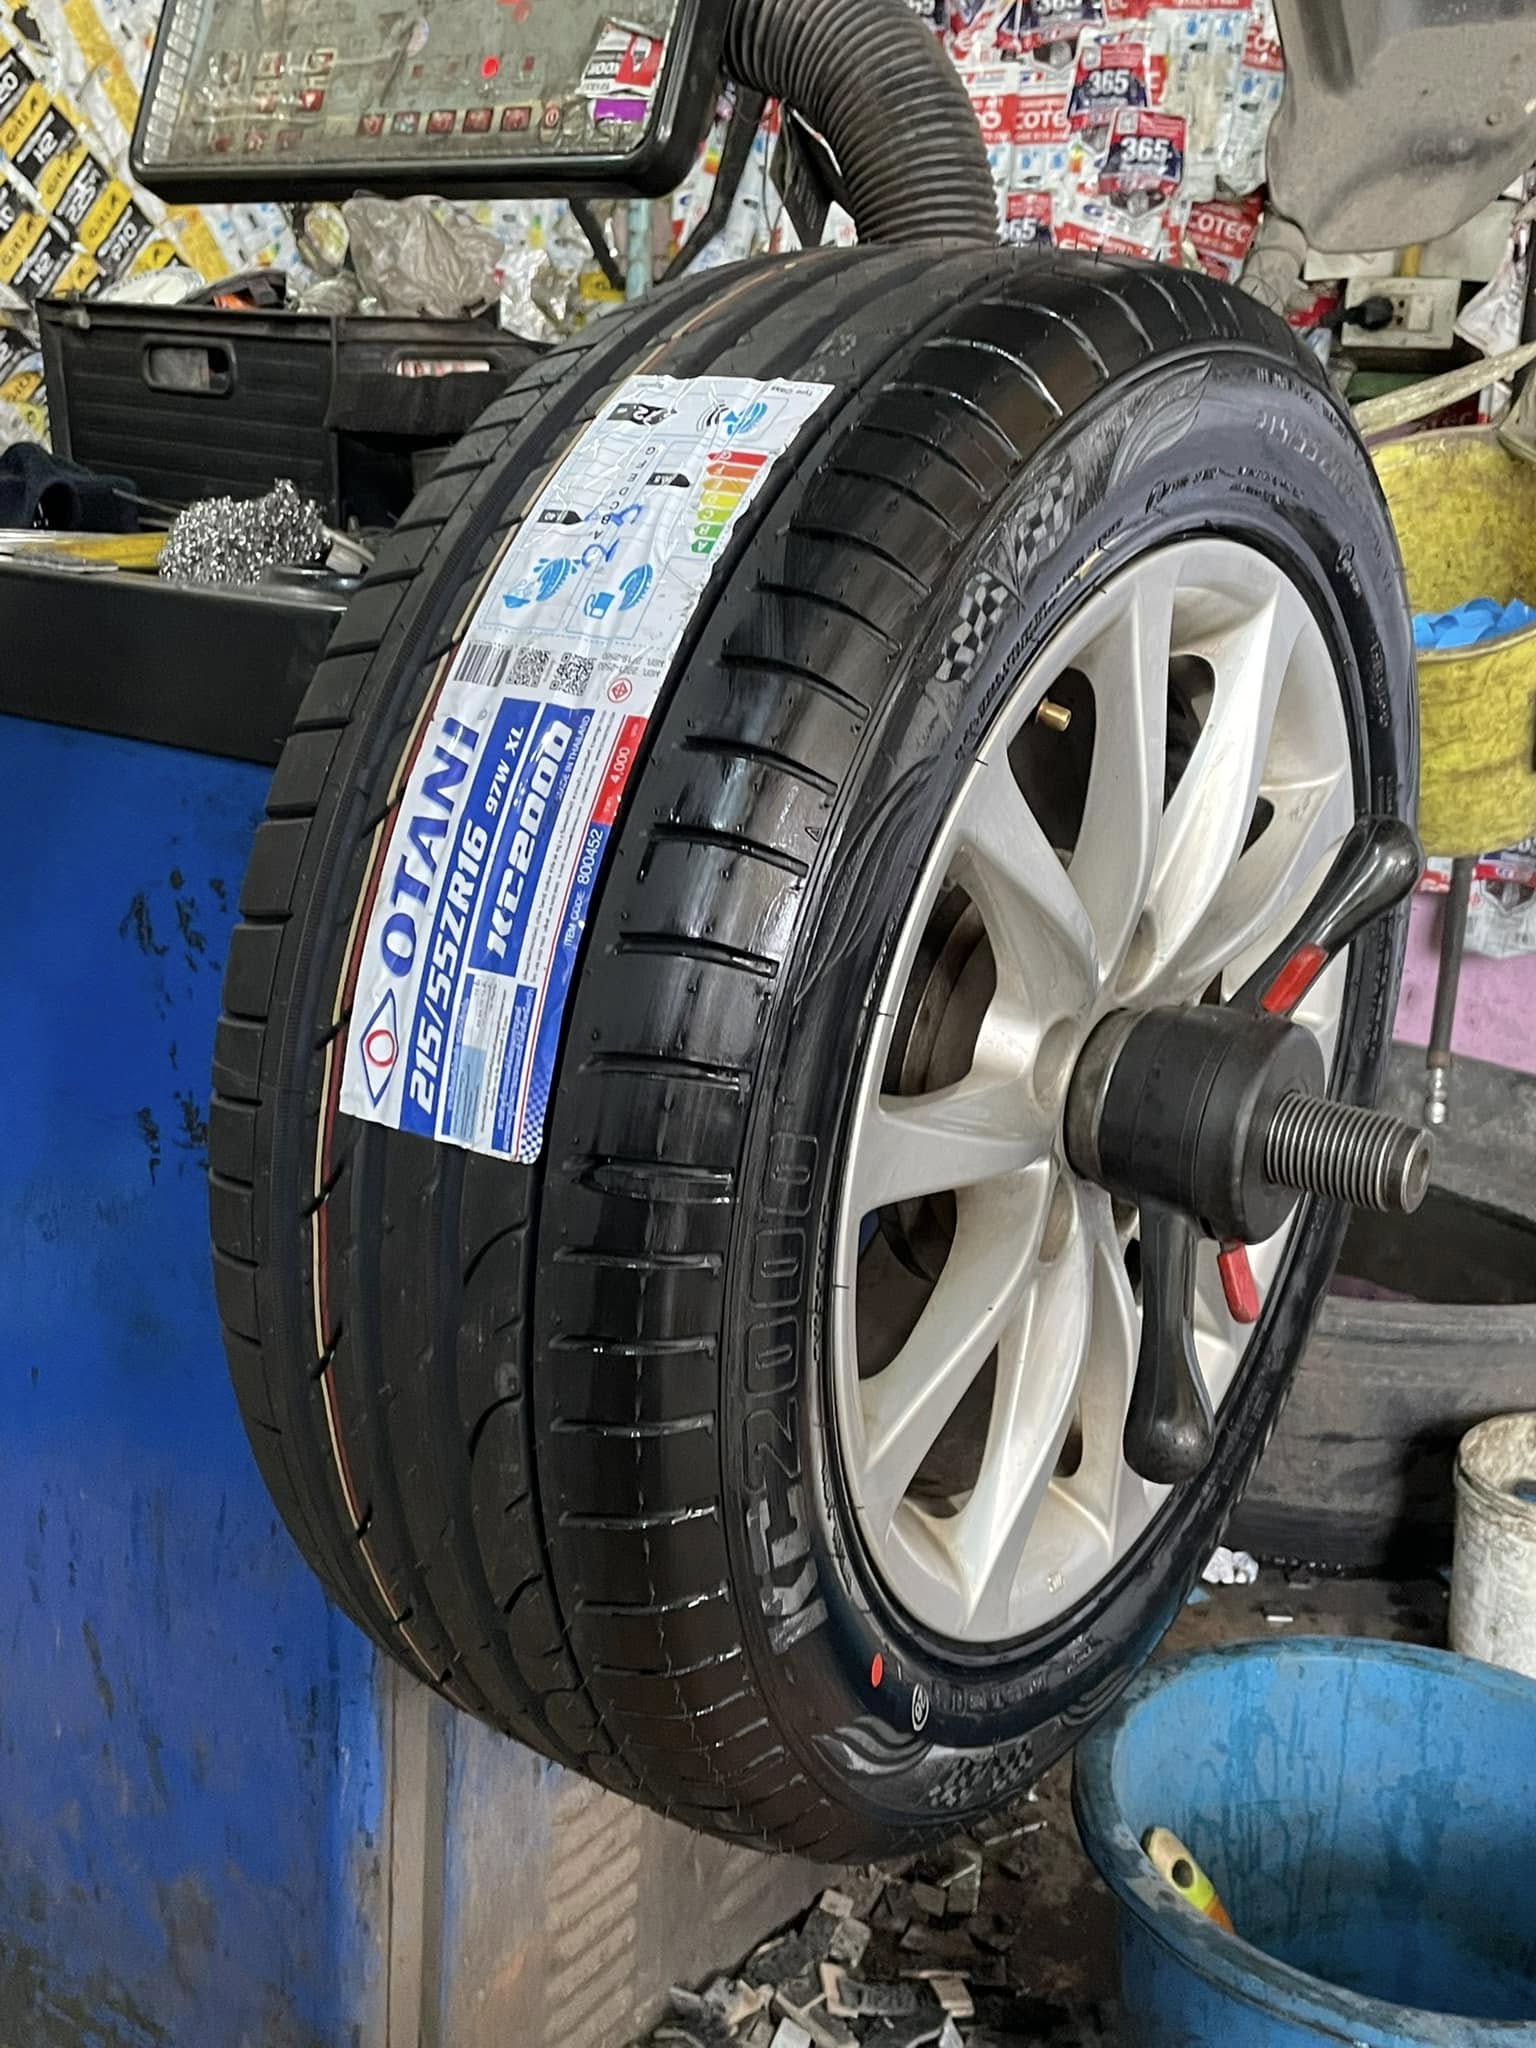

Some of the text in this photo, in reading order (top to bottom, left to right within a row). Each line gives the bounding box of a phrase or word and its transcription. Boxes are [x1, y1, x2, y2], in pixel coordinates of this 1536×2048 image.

[1087, 69, 1131, 97] 365
[1120, 136, 1170, 164] 365
[569, 714, 591, 763] THAILAND
[380, 716, 480, 979] OTANI
[486, 719, 573, 961] KC2000
[563, 923, 578, 948] ITEM
[576, 827, 604, 886] 800452
[410, 818, 489, 1115] 215/55ZR16
[485, 758, 511, 816] 97W
[504, 726, 525, 757] XL
